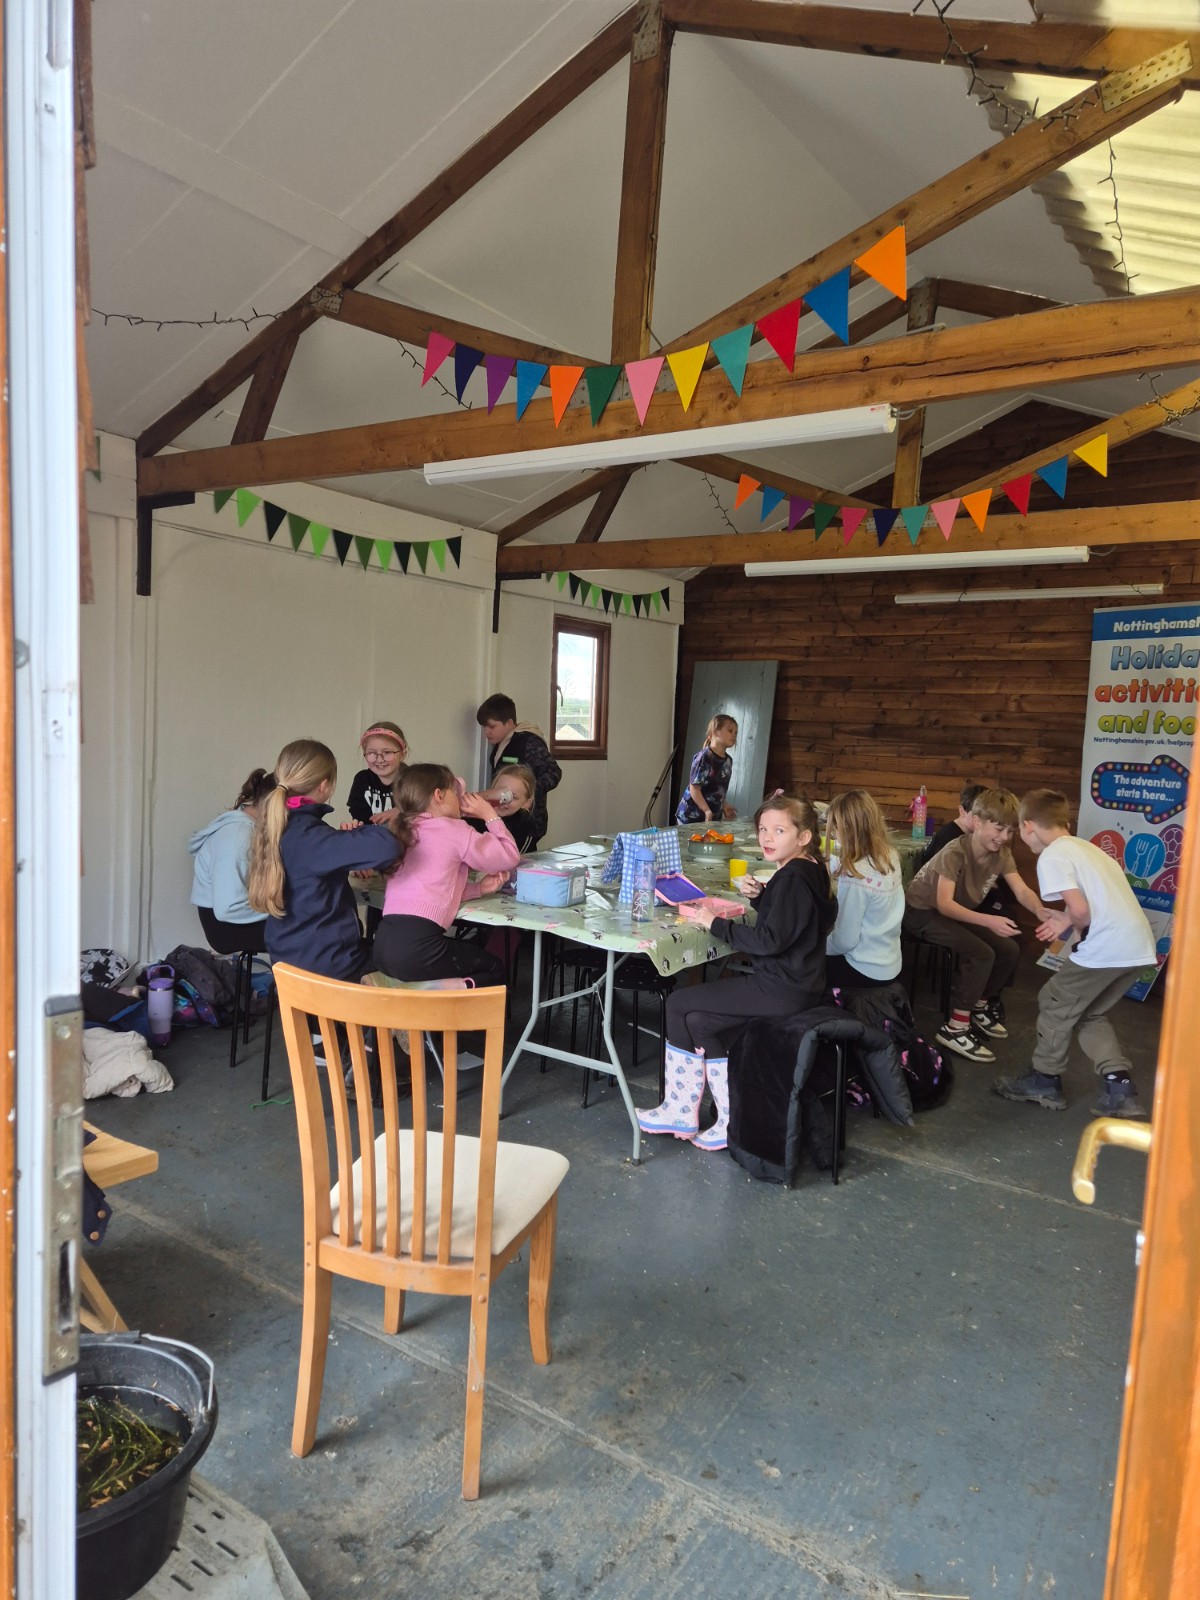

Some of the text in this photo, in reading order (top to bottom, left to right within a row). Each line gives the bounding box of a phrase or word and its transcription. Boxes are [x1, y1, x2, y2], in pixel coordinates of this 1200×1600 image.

[1098, 709, 1196, 735] and foo
[1113, 774, 1182, 789] The adventure
[1116, 788, 1140, 799] starts
